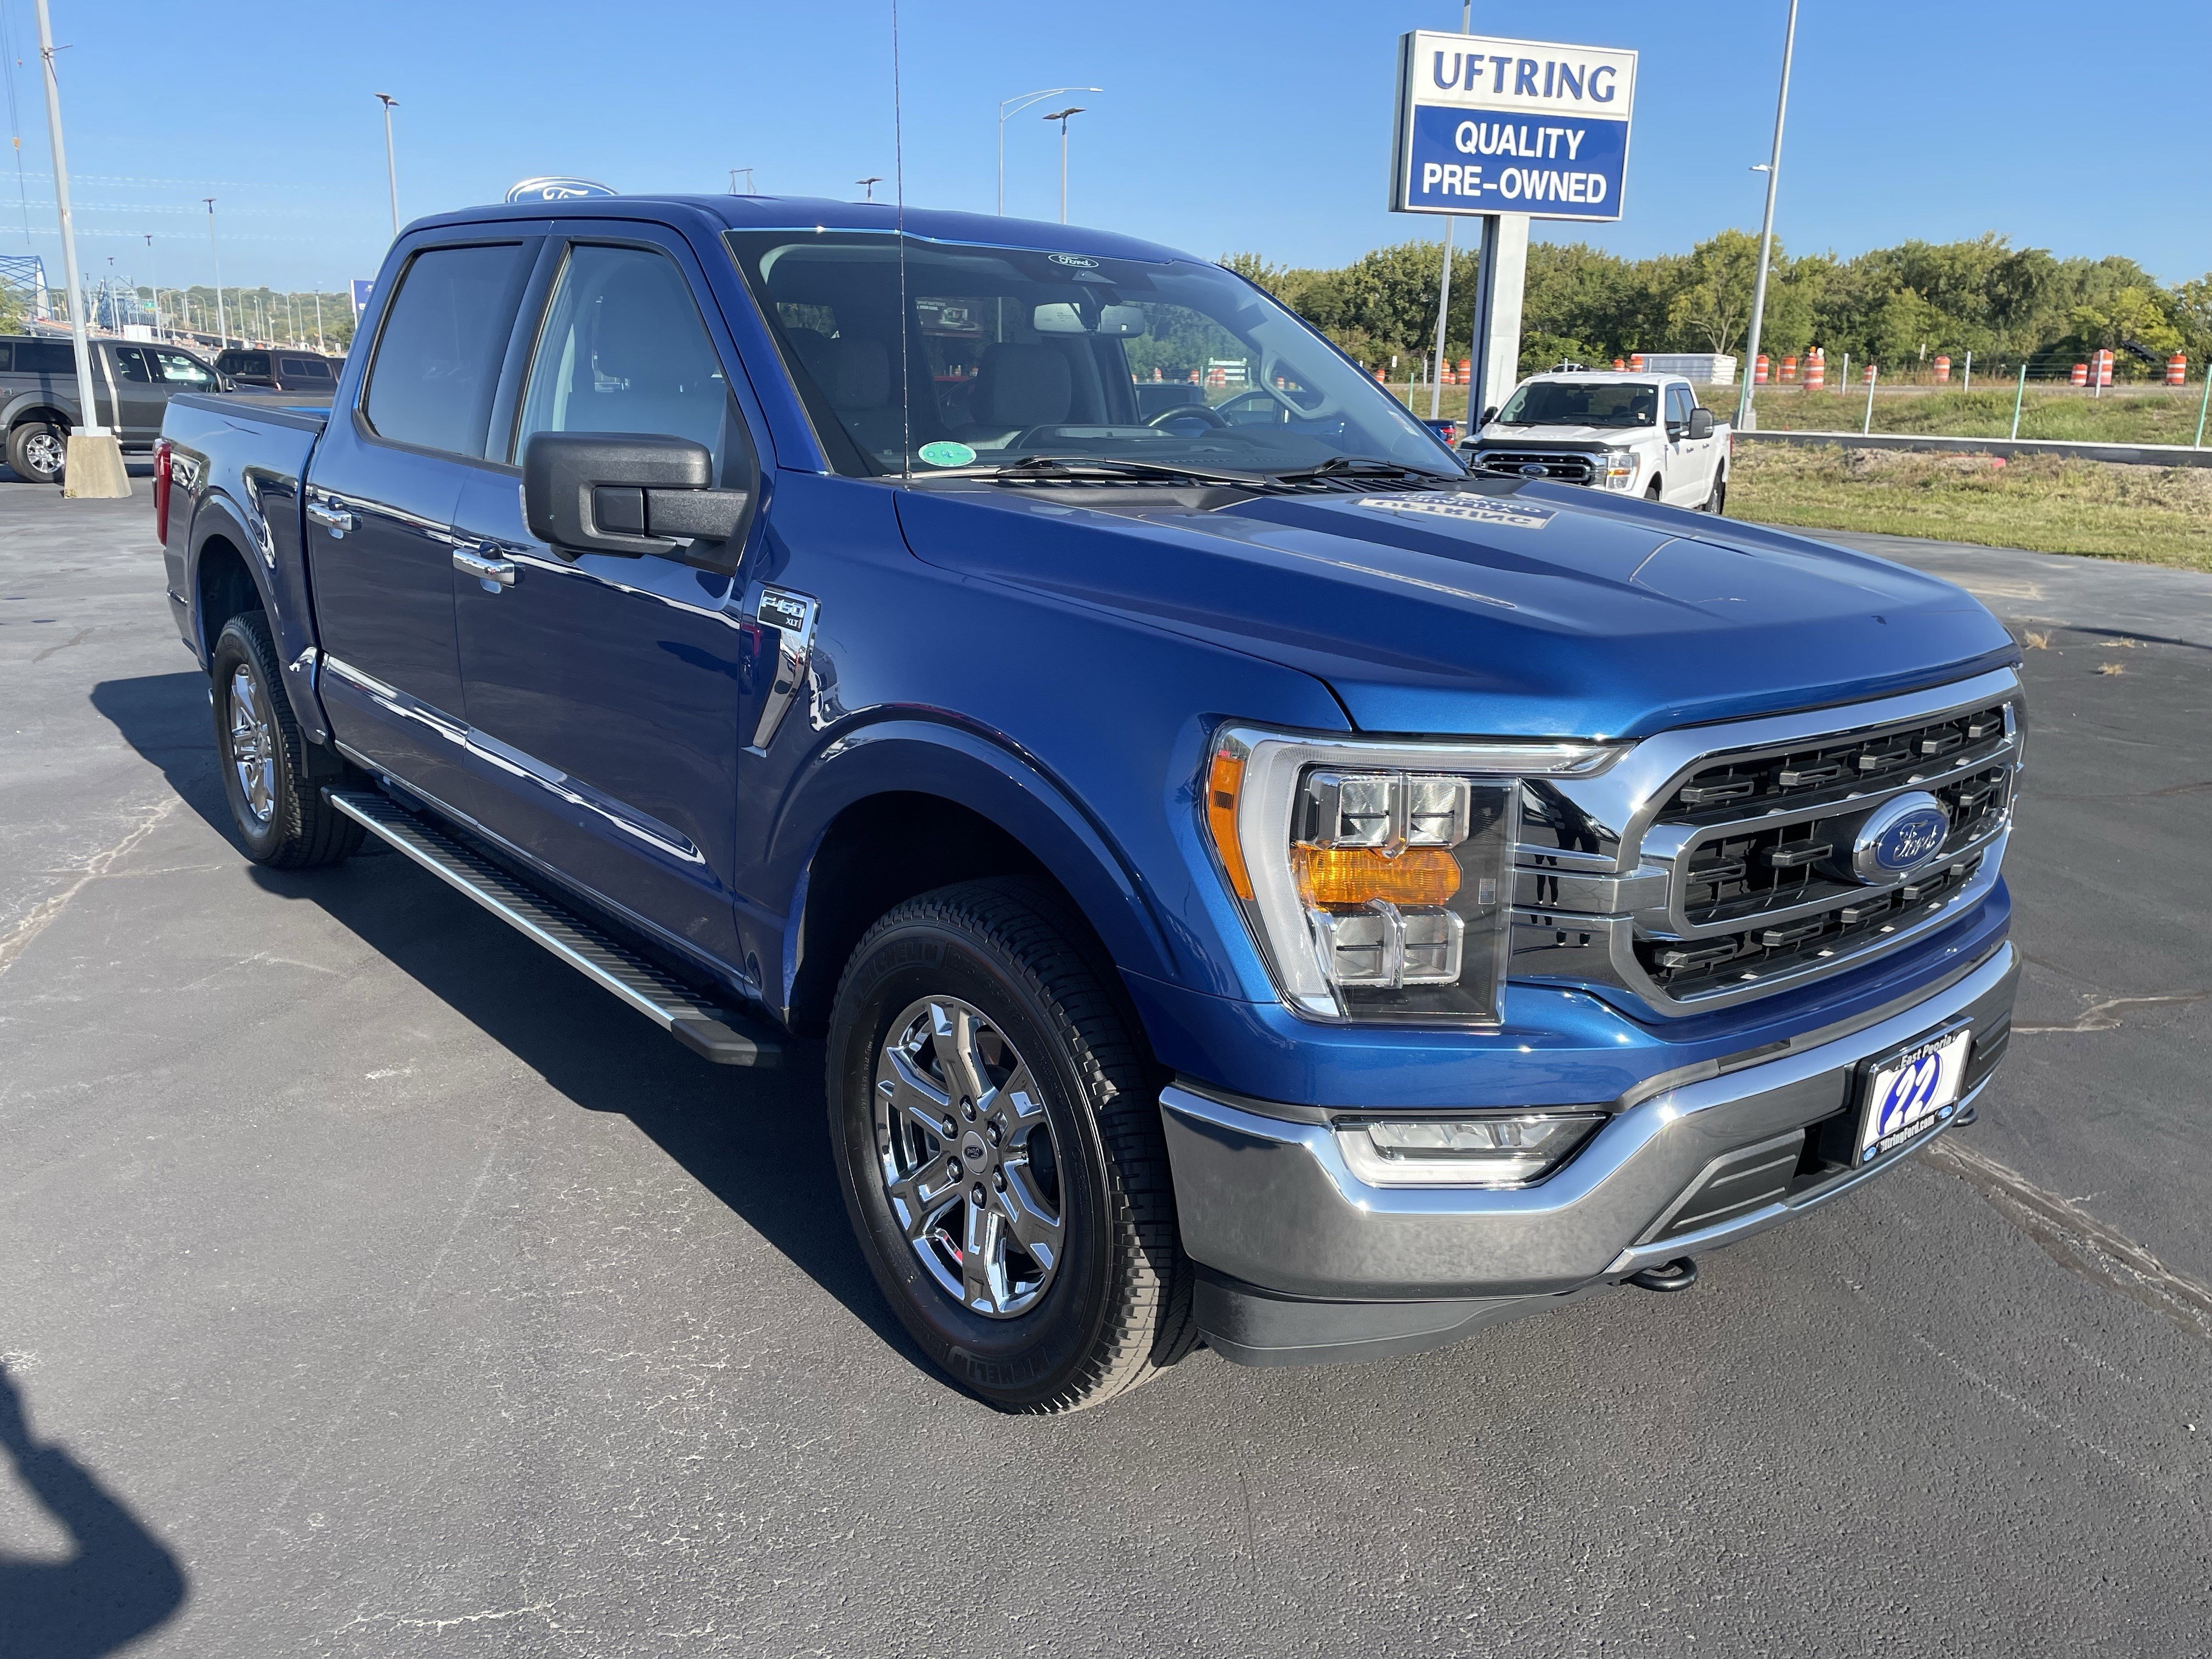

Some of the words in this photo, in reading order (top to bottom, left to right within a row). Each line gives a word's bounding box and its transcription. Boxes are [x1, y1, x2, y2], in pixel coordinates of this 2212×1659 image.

[1433, 50, 1617, 103] UFTRING
[1454, 121, 1585, 160] QUALITY
[1423, 162, 1607, 204] PRE-OWNED
[1058, 255, 1091, 266] Ford
[761, 596, 805, 618] F-150
[785, 617, 799, 627] XLT
[1893, 819, 1938, 862] Ford
[1900, 1048, 1922, 1070] East
[1922, 1034, 1953, 1058] Peoria
[1884, 1054, 1937, 1134] 22
